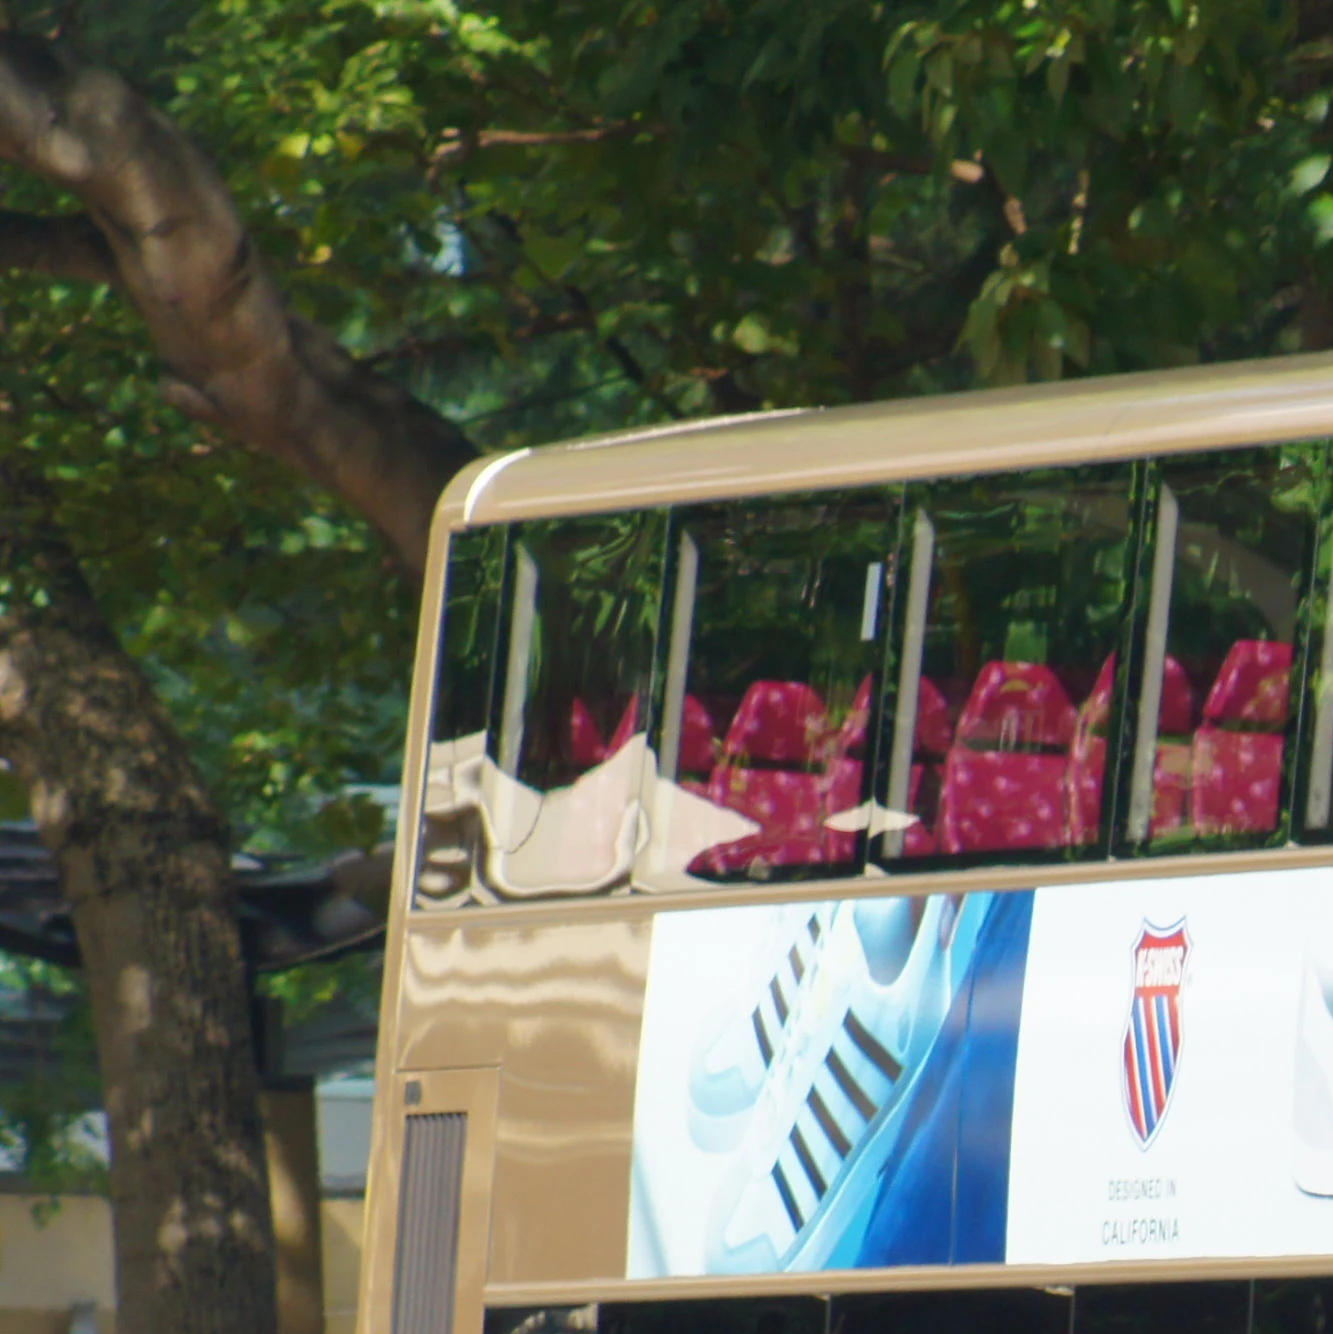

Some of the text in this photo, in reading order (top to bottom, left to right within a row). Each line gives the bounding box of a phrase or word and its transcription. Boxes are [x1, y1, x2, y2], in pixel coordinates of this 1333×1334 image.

[1108, 1178, 1177, 1201] DESIGNED IN
[1102, 1217, 1180, 1245] CALIFORNIA
